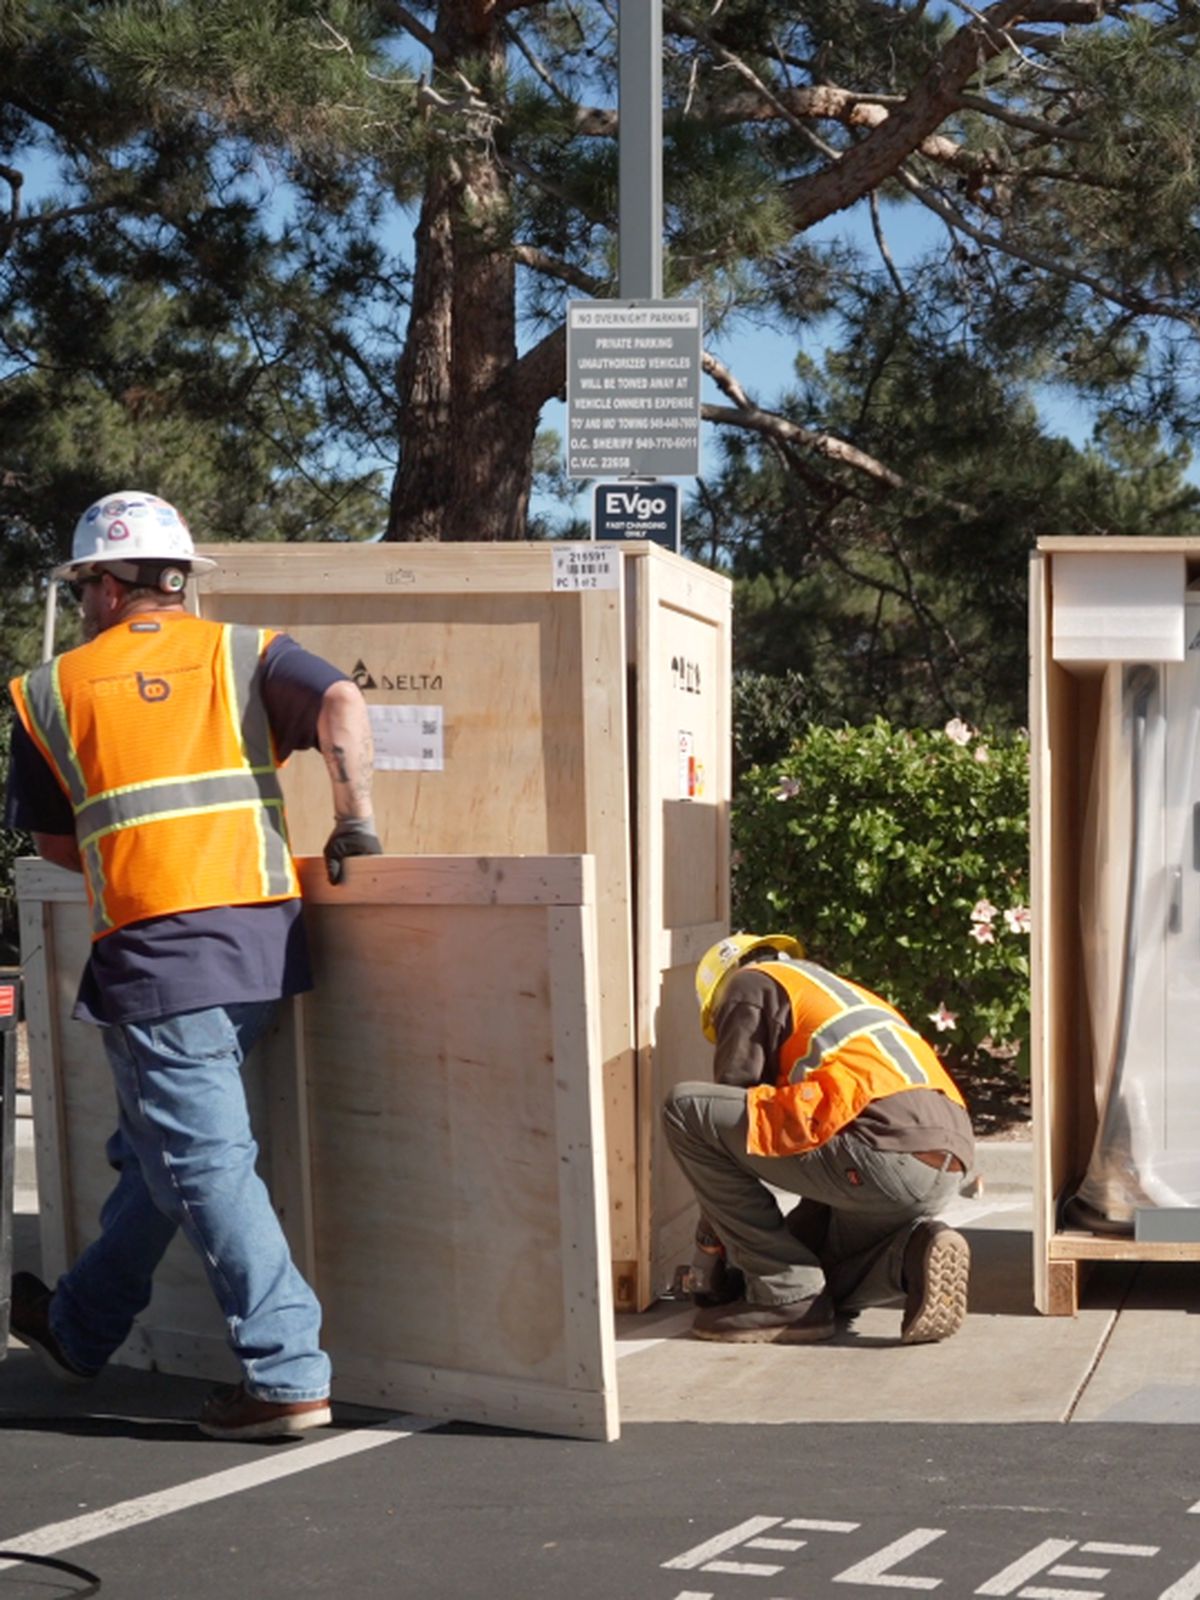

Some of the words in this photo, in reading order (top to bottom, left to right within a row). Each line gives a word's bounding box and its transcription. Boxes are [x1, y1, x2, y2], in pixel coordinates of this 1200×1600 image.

[578, 312, 592, 324] NO
[595, 312, 647, 324] OVERNIGHT
[650, 312, 690, 324] PARKING
[595, 337, 632, 349] PRIVATE
[634, 337, 673, 349] PARKING
[578, 357, 647, 369] UNAUTHORIZED
[649, 357, 690, 369] VEHICLES
[580, 378, 602, 389] WILL
[604, 378, 616, 389] BE
[618, 378, 648, 389] TOWED
[649, 378, 675, 389] AWAY
[676, 378, 688, 389] AT
[575, 397, 611, 409] VEHICLE
[613, 397, 652, 409] OWNER'S
[654, 397, 694, 409] EXPENSE
[584, 418, 601, 429] AND
[618, 418, 648, 429] TOWING
[570, 438, 590, 449] O.C.
[592, 438, 633, 449] SHERIFF
[606, 493, 666, 519] EVgo
[606, 522, 625, 530] FAST
[626, 522, 667, 530] CHARGING
[381, 675, 443, 690] DELTA
